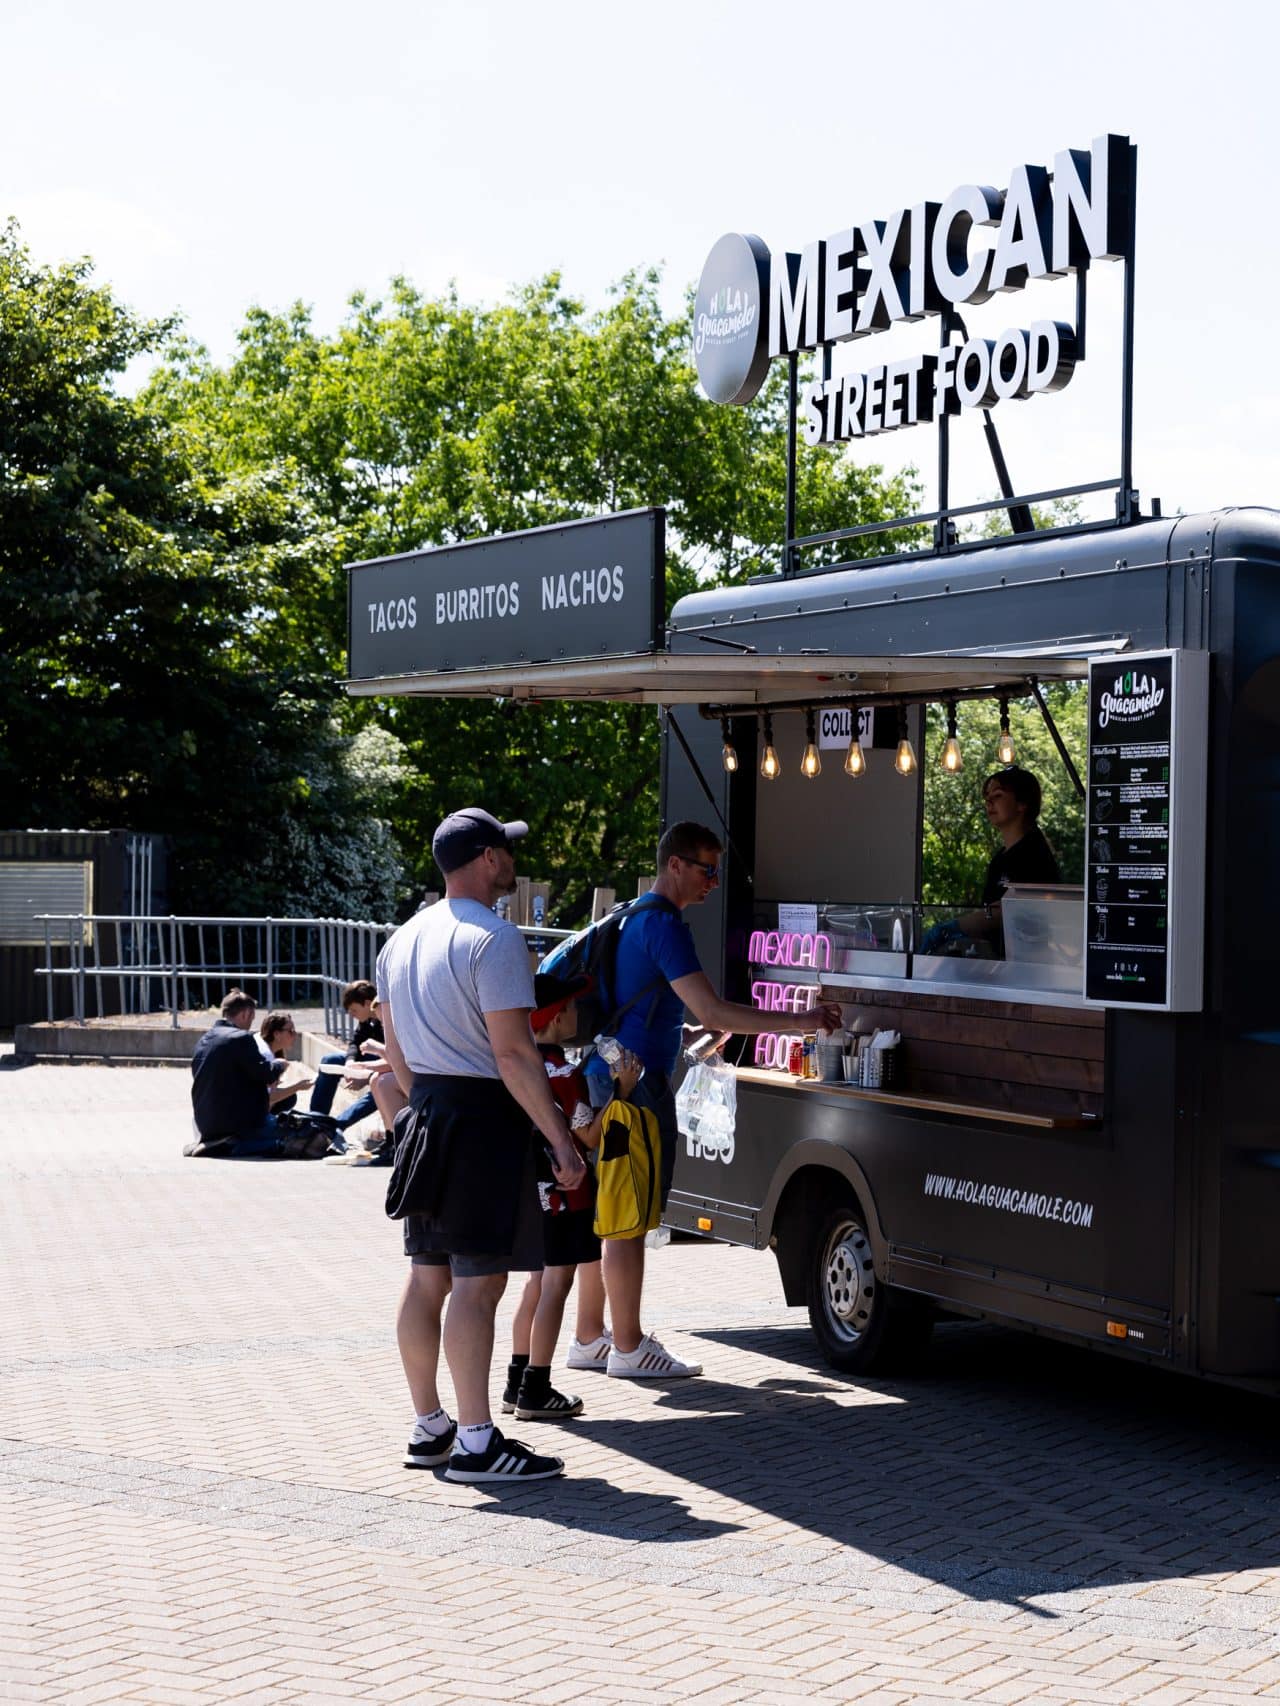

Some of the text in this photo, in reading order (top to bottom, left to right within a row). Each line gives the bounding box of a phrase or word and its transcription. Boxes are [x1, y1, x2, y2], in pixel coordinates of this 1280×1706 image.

[769, 133, 1118, 358] MEXICAN
[710, 286, 742, 316] HOLA
[805, 319, 1066, 447] STREET FOOD
[368, 565, 624, 633] TACOS BURRITOS NACHOS
[1099, 677, 1164, 728] guacamole
[1114, 672, 1150, 696] HOLA
[822, 710, 871, 738] COLLCT
[748, 930, 830, 970] MEXICAN
[752, 981, 820, 1014] STREET
[755, 1032, 800, 1069] FOO
[924, 1173, 1094, 1228] WWW.HOLAGUACAMOLE.COM
